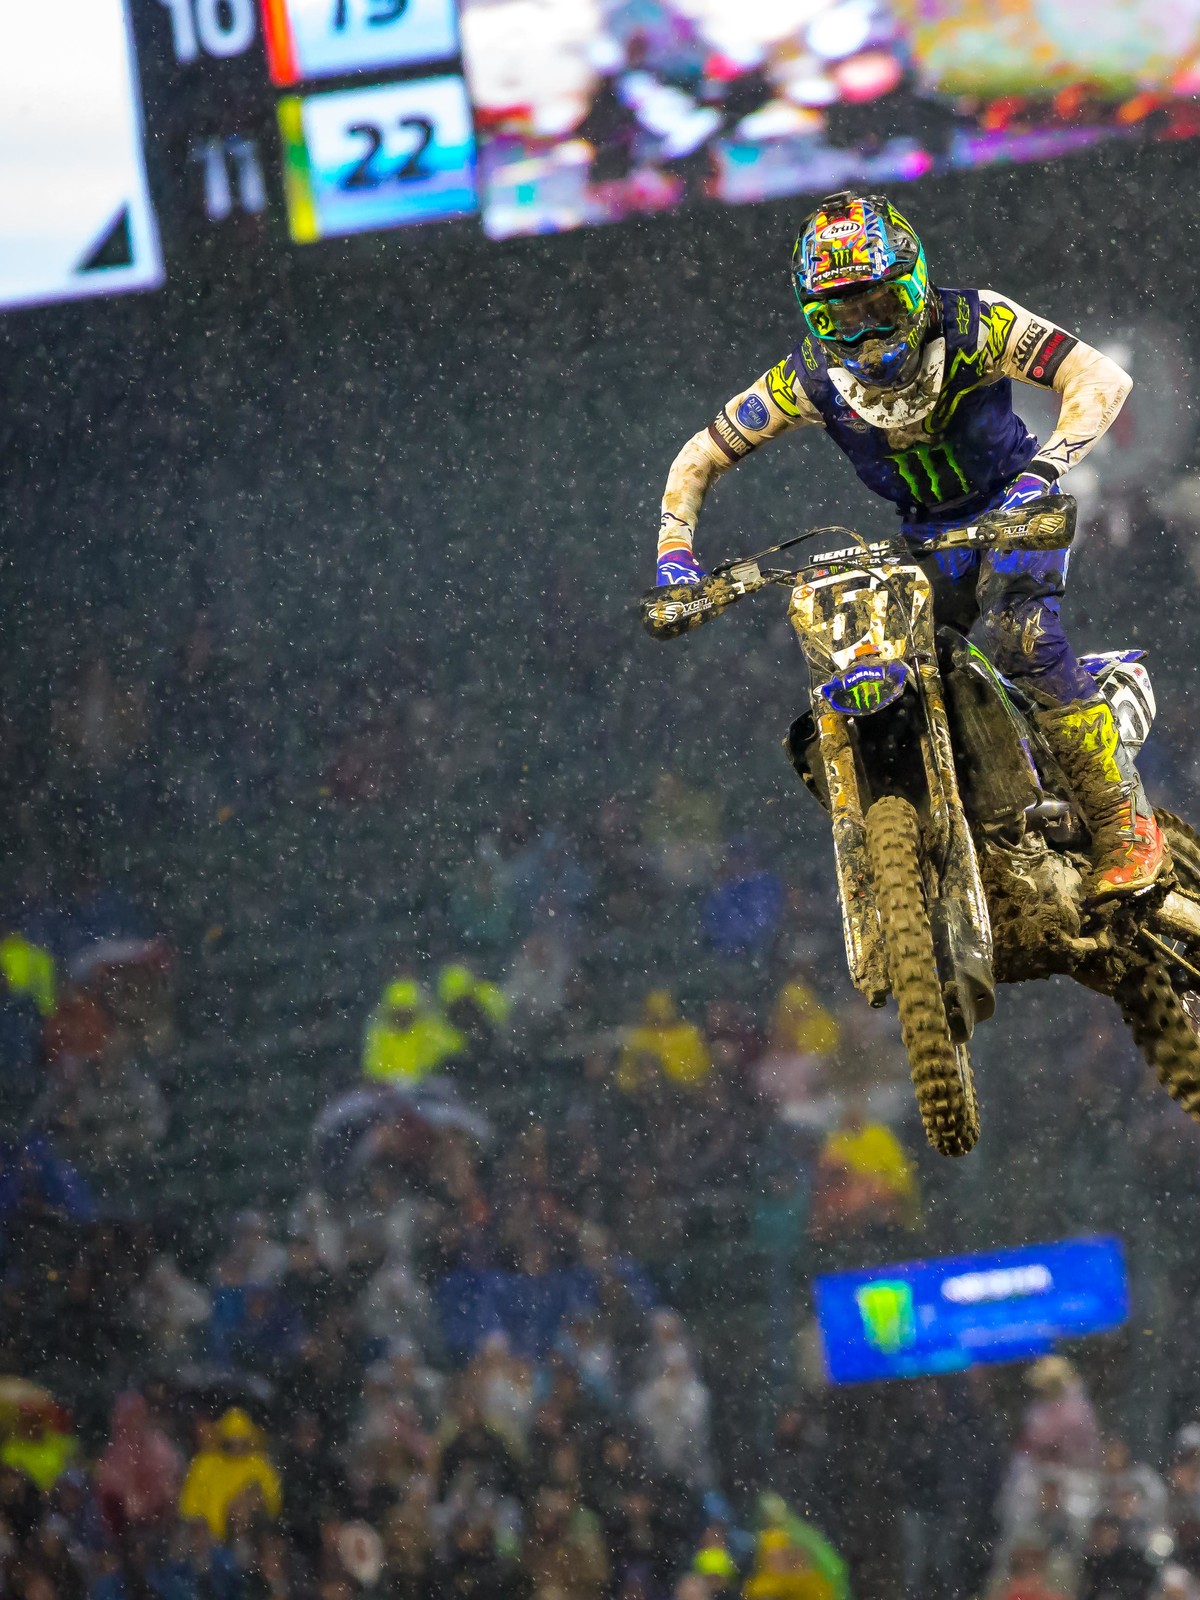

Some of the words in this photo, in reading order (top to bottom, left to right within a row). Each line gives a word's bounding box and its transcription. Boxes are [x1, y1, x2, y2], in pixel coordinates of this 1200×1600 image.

[158, 0, 256, 63] 10
[193, 136, 266, 221] 11
[343, 114, 437, 190] 22
[714, 410, 750, 456] YAMALUBE
[847, 671, 881, 683] YAMAHA
